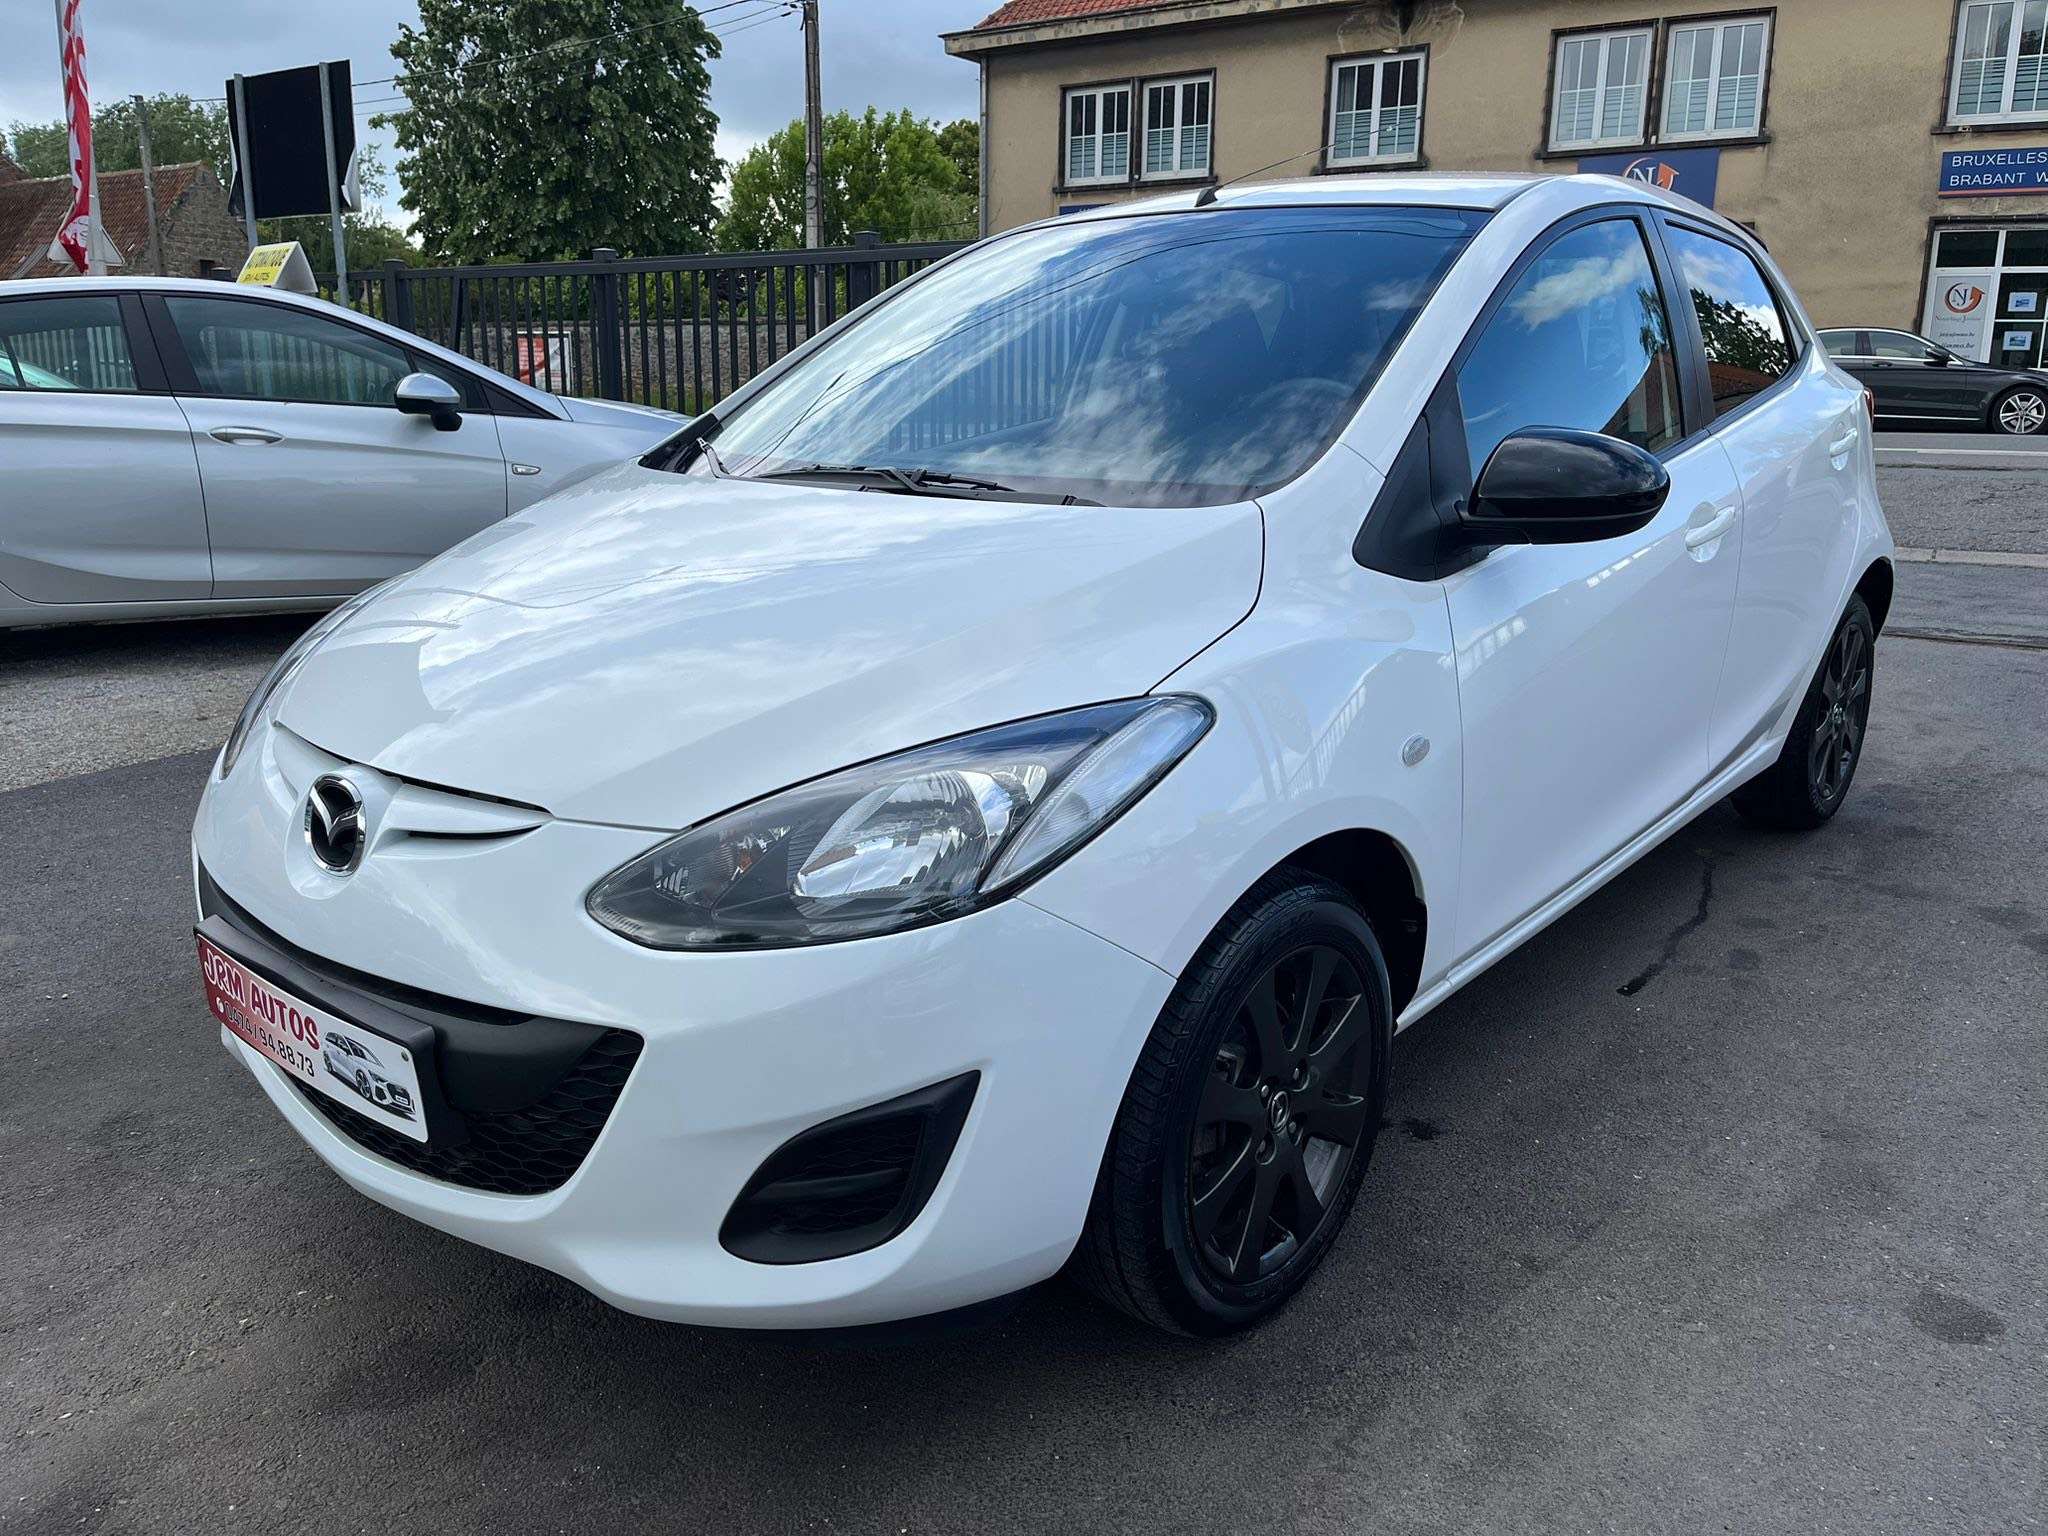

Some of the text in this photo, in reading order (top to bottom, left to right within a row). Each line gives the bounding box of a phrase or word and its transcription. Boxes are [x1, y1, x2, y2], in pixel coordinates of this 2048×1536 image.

[1951, 151, 2048, 167] BRUXELLES
[1949, 171, 2026, 187] BRABANT
[250, 981, 320, 1050] AUTOS
